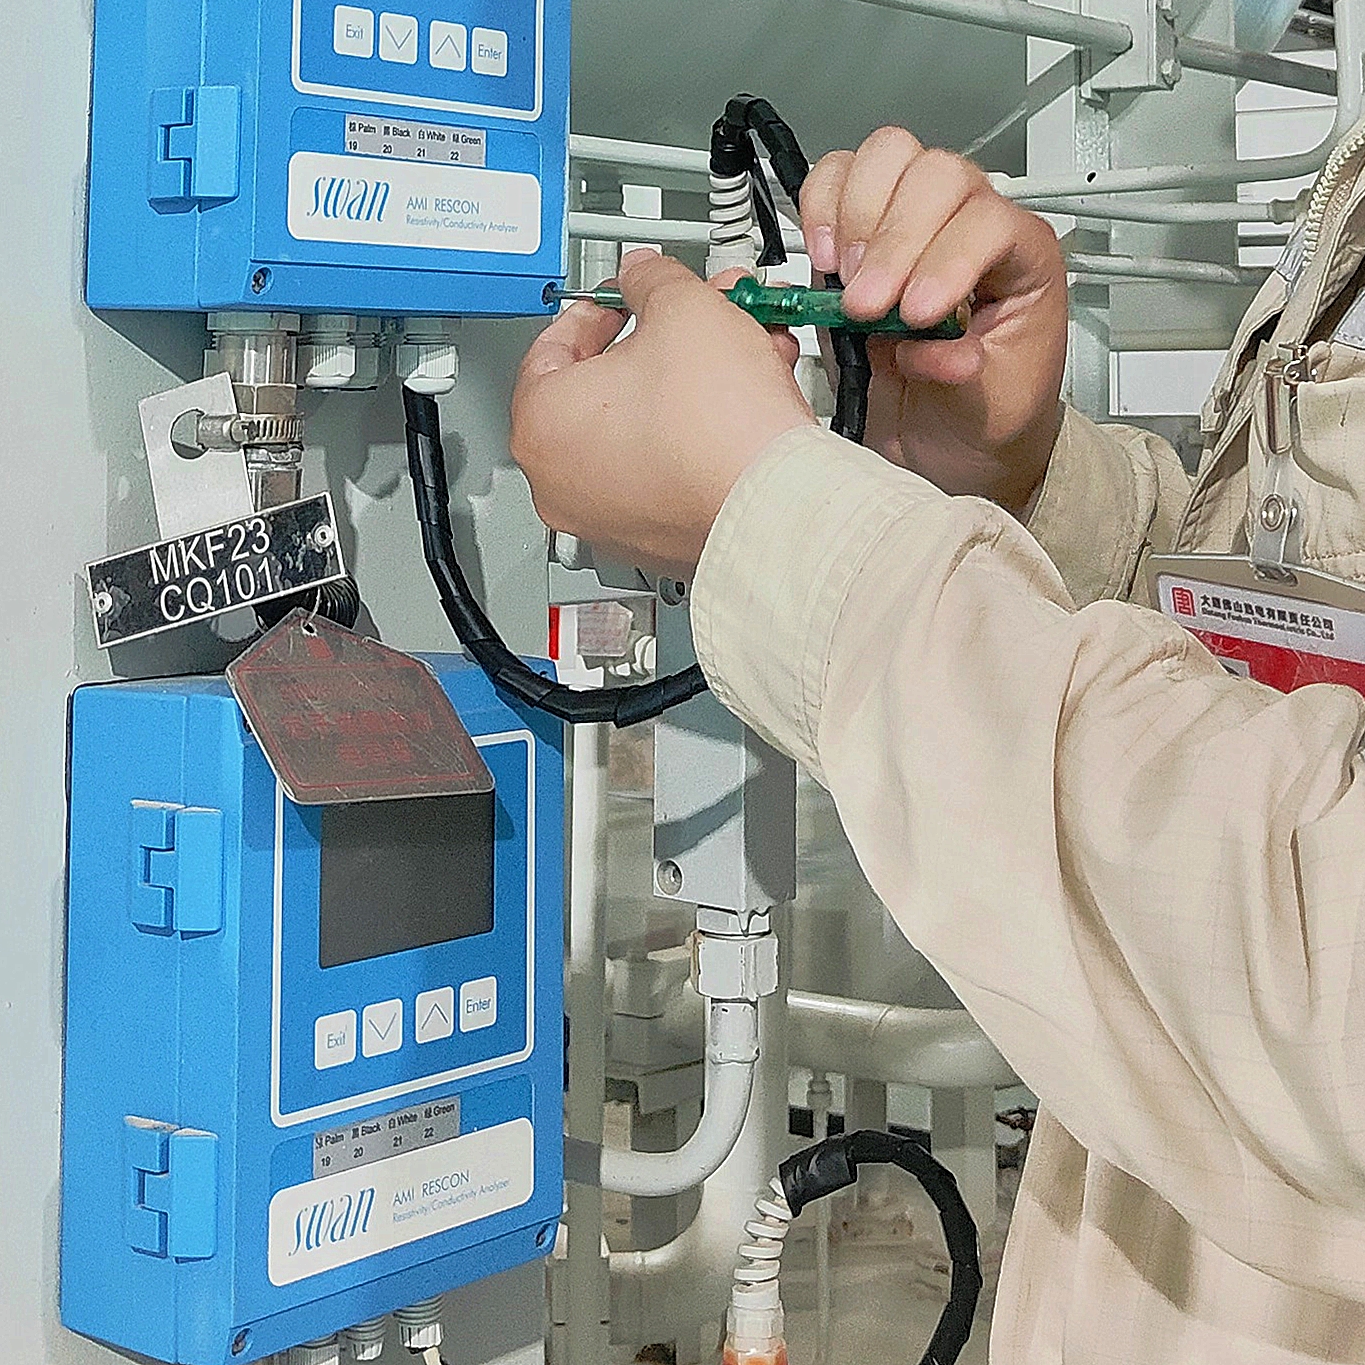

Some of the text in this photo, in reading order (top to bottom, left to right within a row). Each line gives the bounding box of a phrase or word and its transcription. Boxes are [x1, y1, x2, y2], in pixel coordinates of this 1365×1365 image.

[345, 23, 364, 41] Exit
[477, 42, 503, 61] Enter
[392, 127, 411, 138] Black
[426, 130, 446, 142] White
[461, 133, 482, 146] Green
[348, 141, 460, 161] 19 20 21 22
[306, 176, 391, 223] swan
[406, 196, 480, 215] AMI RESCON
[489, 220, 519, 234] Analyzer
[149, 518, 272, 585] MKF23
[159, 559, 276, 622] CQ101
[466, 995, 492, 1014] Enter
[326, 1028, 347, 1049] Exit
[361, 1123, 381, 1136] Black
[397, 1113, 418, 1126] White
[433, 1103, 455, 1116] Green
[321, 1127, 434, 1167] 19 20 21 22
[392, 1169, 471, 1206] AMI RESCON
[288, 1186, 376, 1256] swan
